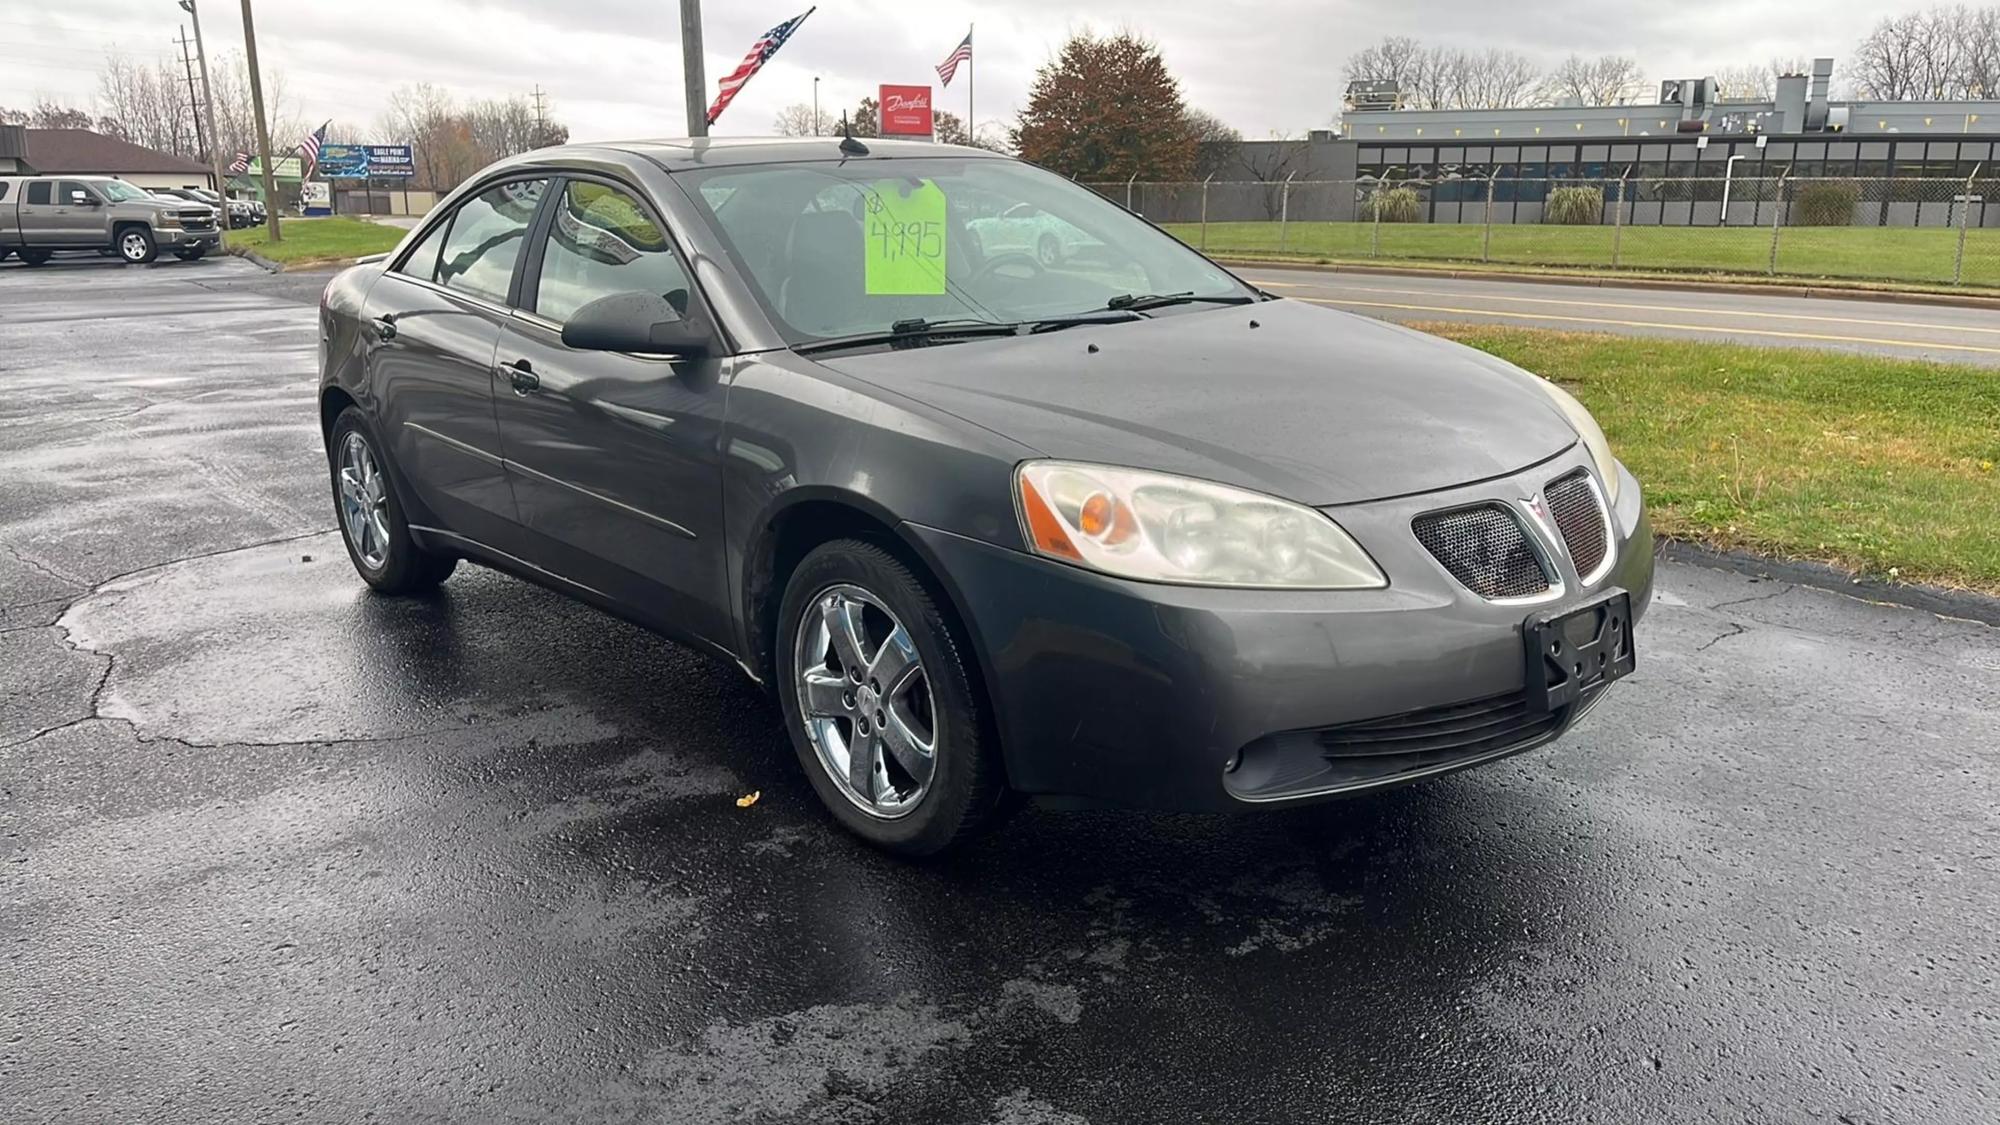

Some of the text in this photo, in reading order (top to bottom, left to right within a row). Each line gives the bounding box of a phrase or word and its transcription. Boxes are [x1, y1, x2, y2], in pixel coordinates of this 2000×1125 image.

[886, 94, 928, 111] Danfoss
[868, 196, 884, 215] $
[871, 221, 942, 262] 4,995
